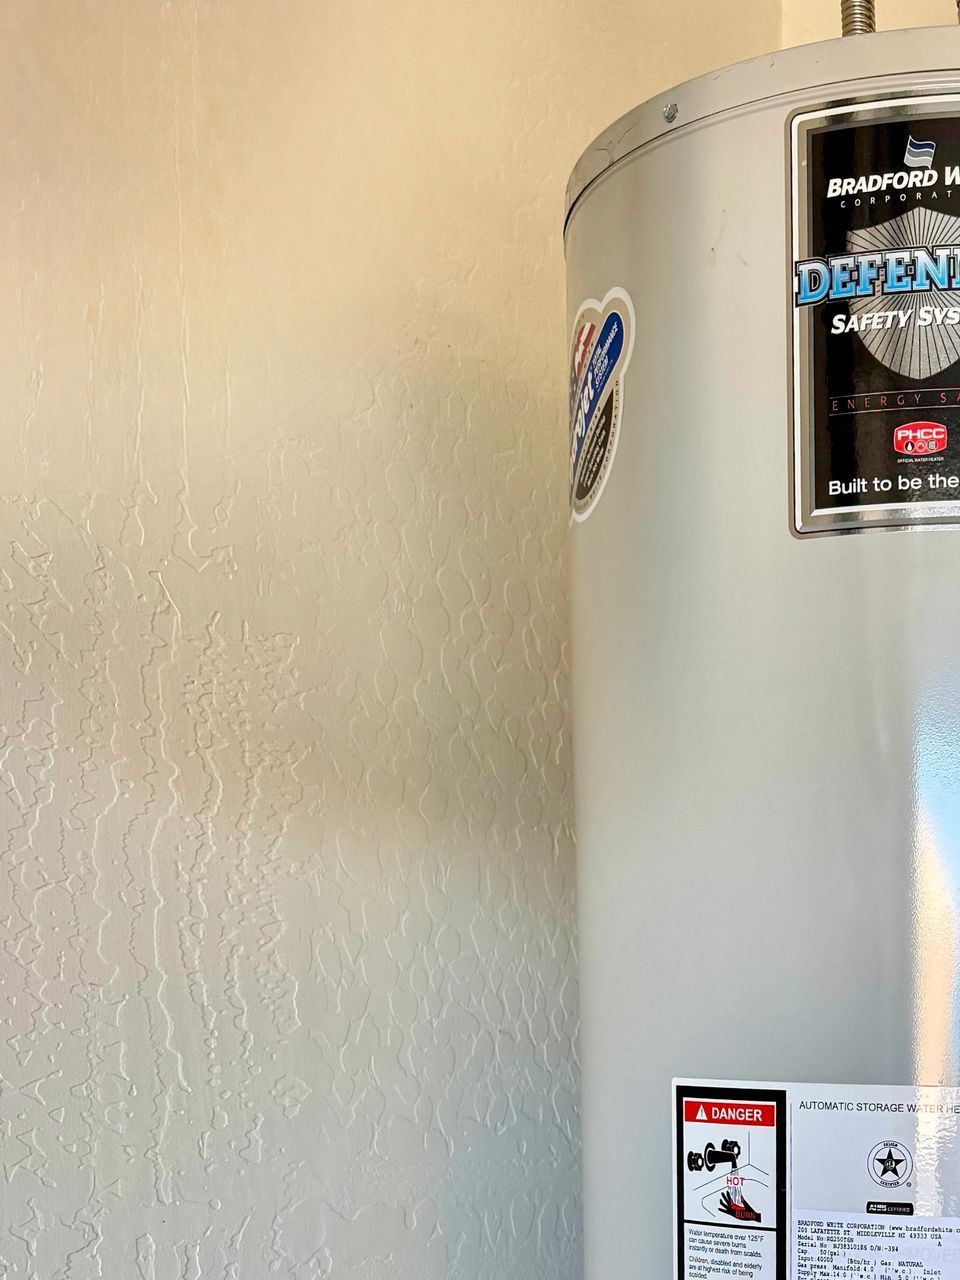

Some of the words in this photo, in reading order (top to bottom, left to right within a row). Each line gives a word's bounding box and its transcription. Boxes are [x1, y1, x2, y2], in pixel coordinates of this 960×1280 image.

[827, 170, 938, 198] BRADFORD
[831, 309, 914, 335] SAFETY
[832, 393, 922, 411] ENERGY
[897, 428, 945, 441] PHCC
[829, 477, 867, 496] Built
[873, 477, 892, 491] to
[898, 475, 922, 490] be
[930, 474, 960, 489] the
[712, 1107, 762, 1122] DANGER
[799, 1101, 854, 1112] AUTOMATIC
[857, 1103, 904, 1113] STORAGE
[726, 1176, 745, 1187] HOT
